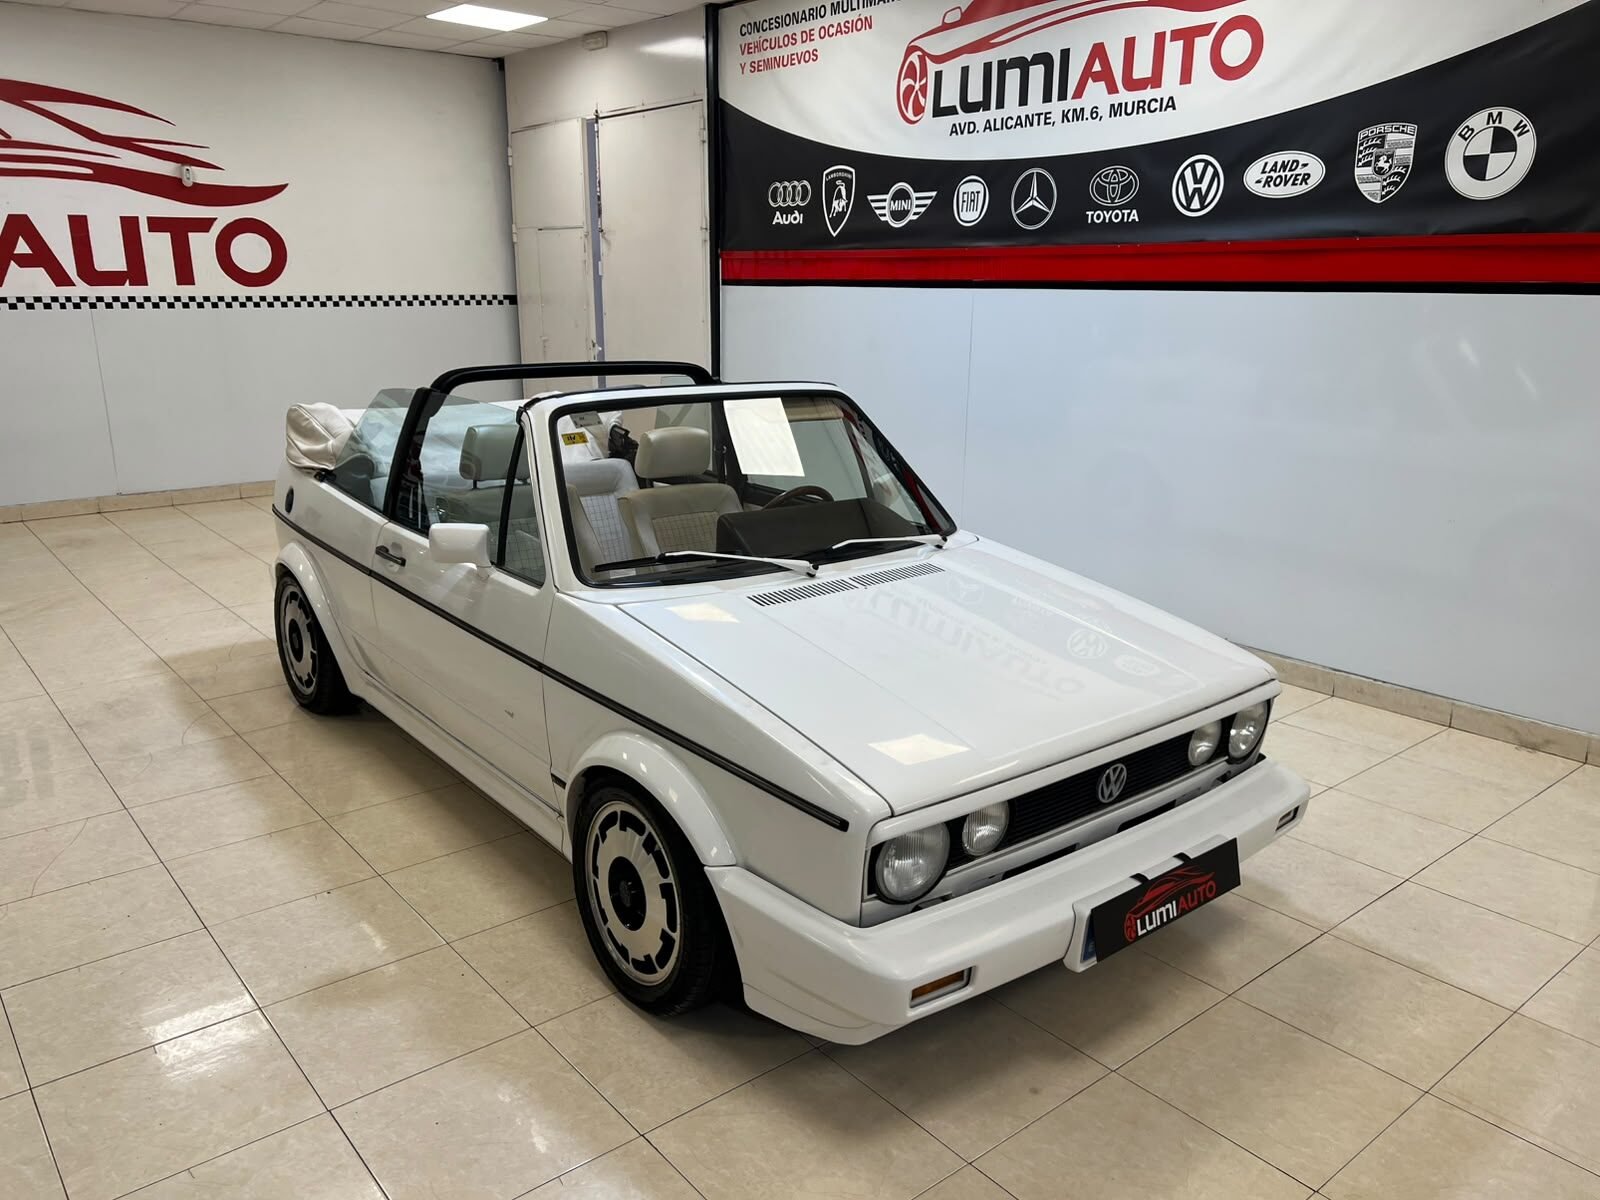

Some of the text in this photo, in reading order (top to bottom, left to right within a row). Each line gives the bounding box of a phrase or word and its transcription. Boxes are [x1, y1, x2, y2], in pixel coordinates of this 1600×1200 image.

[739, 4, 827, 37] CONCESIONARIO
[739, 14, 873, 56] VEHÍCULOS DE OCASIÓN
[739, 48, 819, 75] Y SEMINUEVOS
[949, 95, 1177, 136] AVD. ALICANTE, KM.6, MURCIA
[1457, 111, 1530, 142] BMW
[1359, 124, 1416, 140] PORSCHE
[889, 199, 912, 212] MINI
[960, 190, 981, 213] FIAT
[772, 210, 804, 225] Audi
[1086, 209, 1140, 224] TOYOTA
